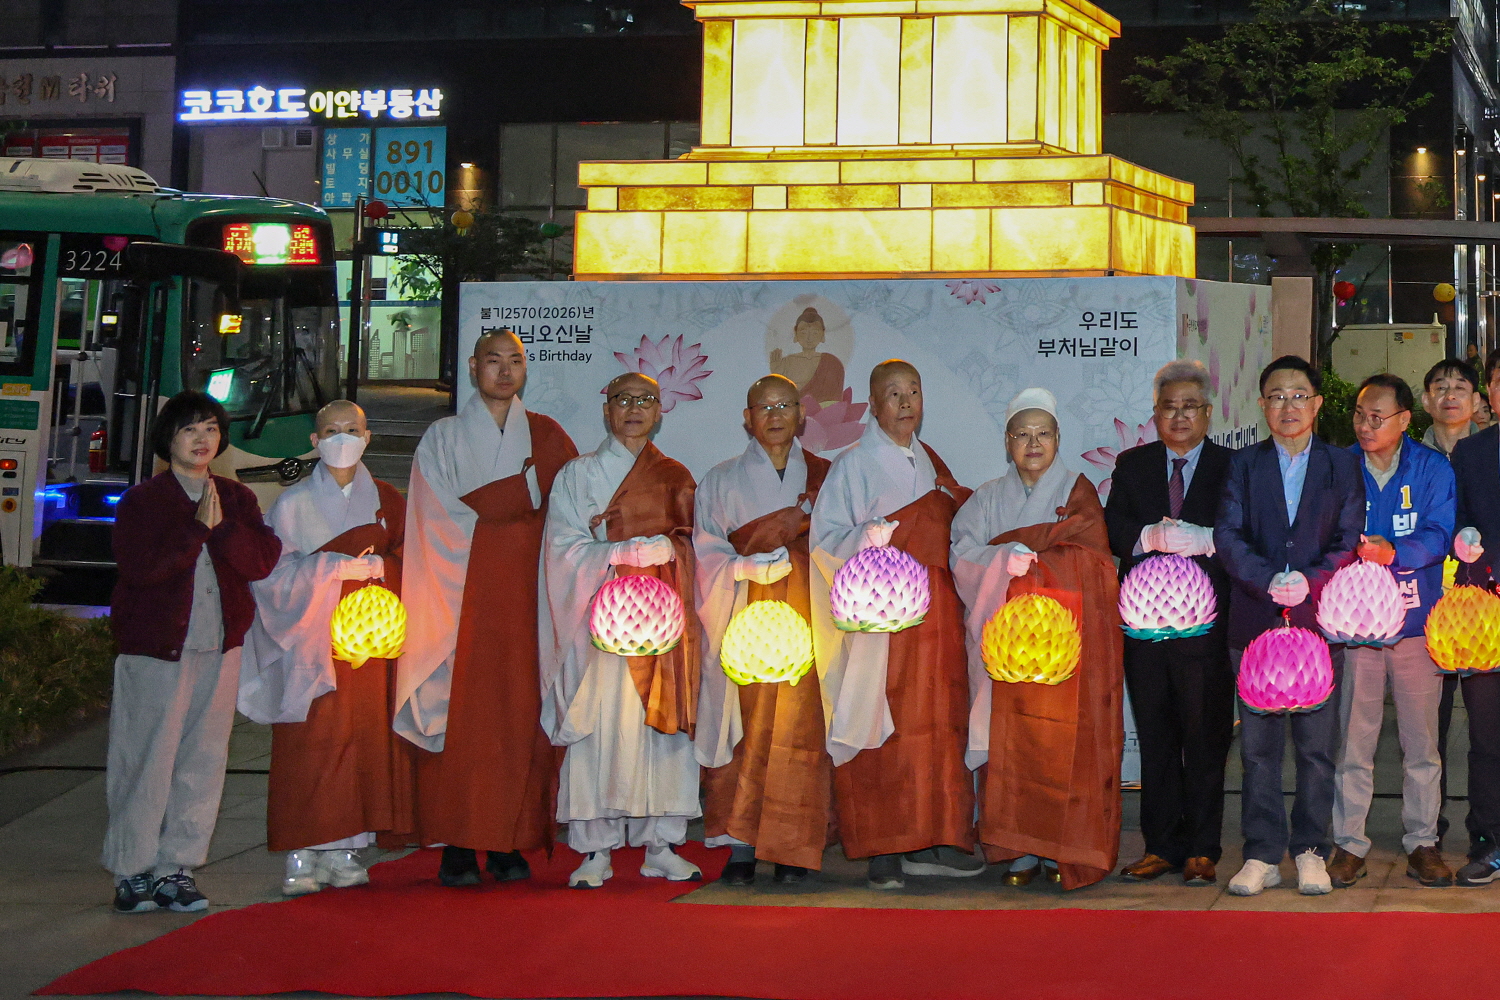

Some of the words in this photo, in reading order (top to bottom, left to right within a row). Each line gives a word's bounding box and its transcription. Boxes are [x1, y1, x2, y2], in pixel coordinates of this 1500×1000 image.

[385, 139, 433, 164] 891
[376, 170, 443, 194] 0010
[65, 250, 122, 271] 3224
[480, 306, 595, 320] 불기2570(2026)년
[1079, 311, 1138, 330] 우리도
[539, 350, 592, 364] Birthday
[1038, 337, 1137, 357] 부처님같이
[1400, 485, 1413, 509] 1
